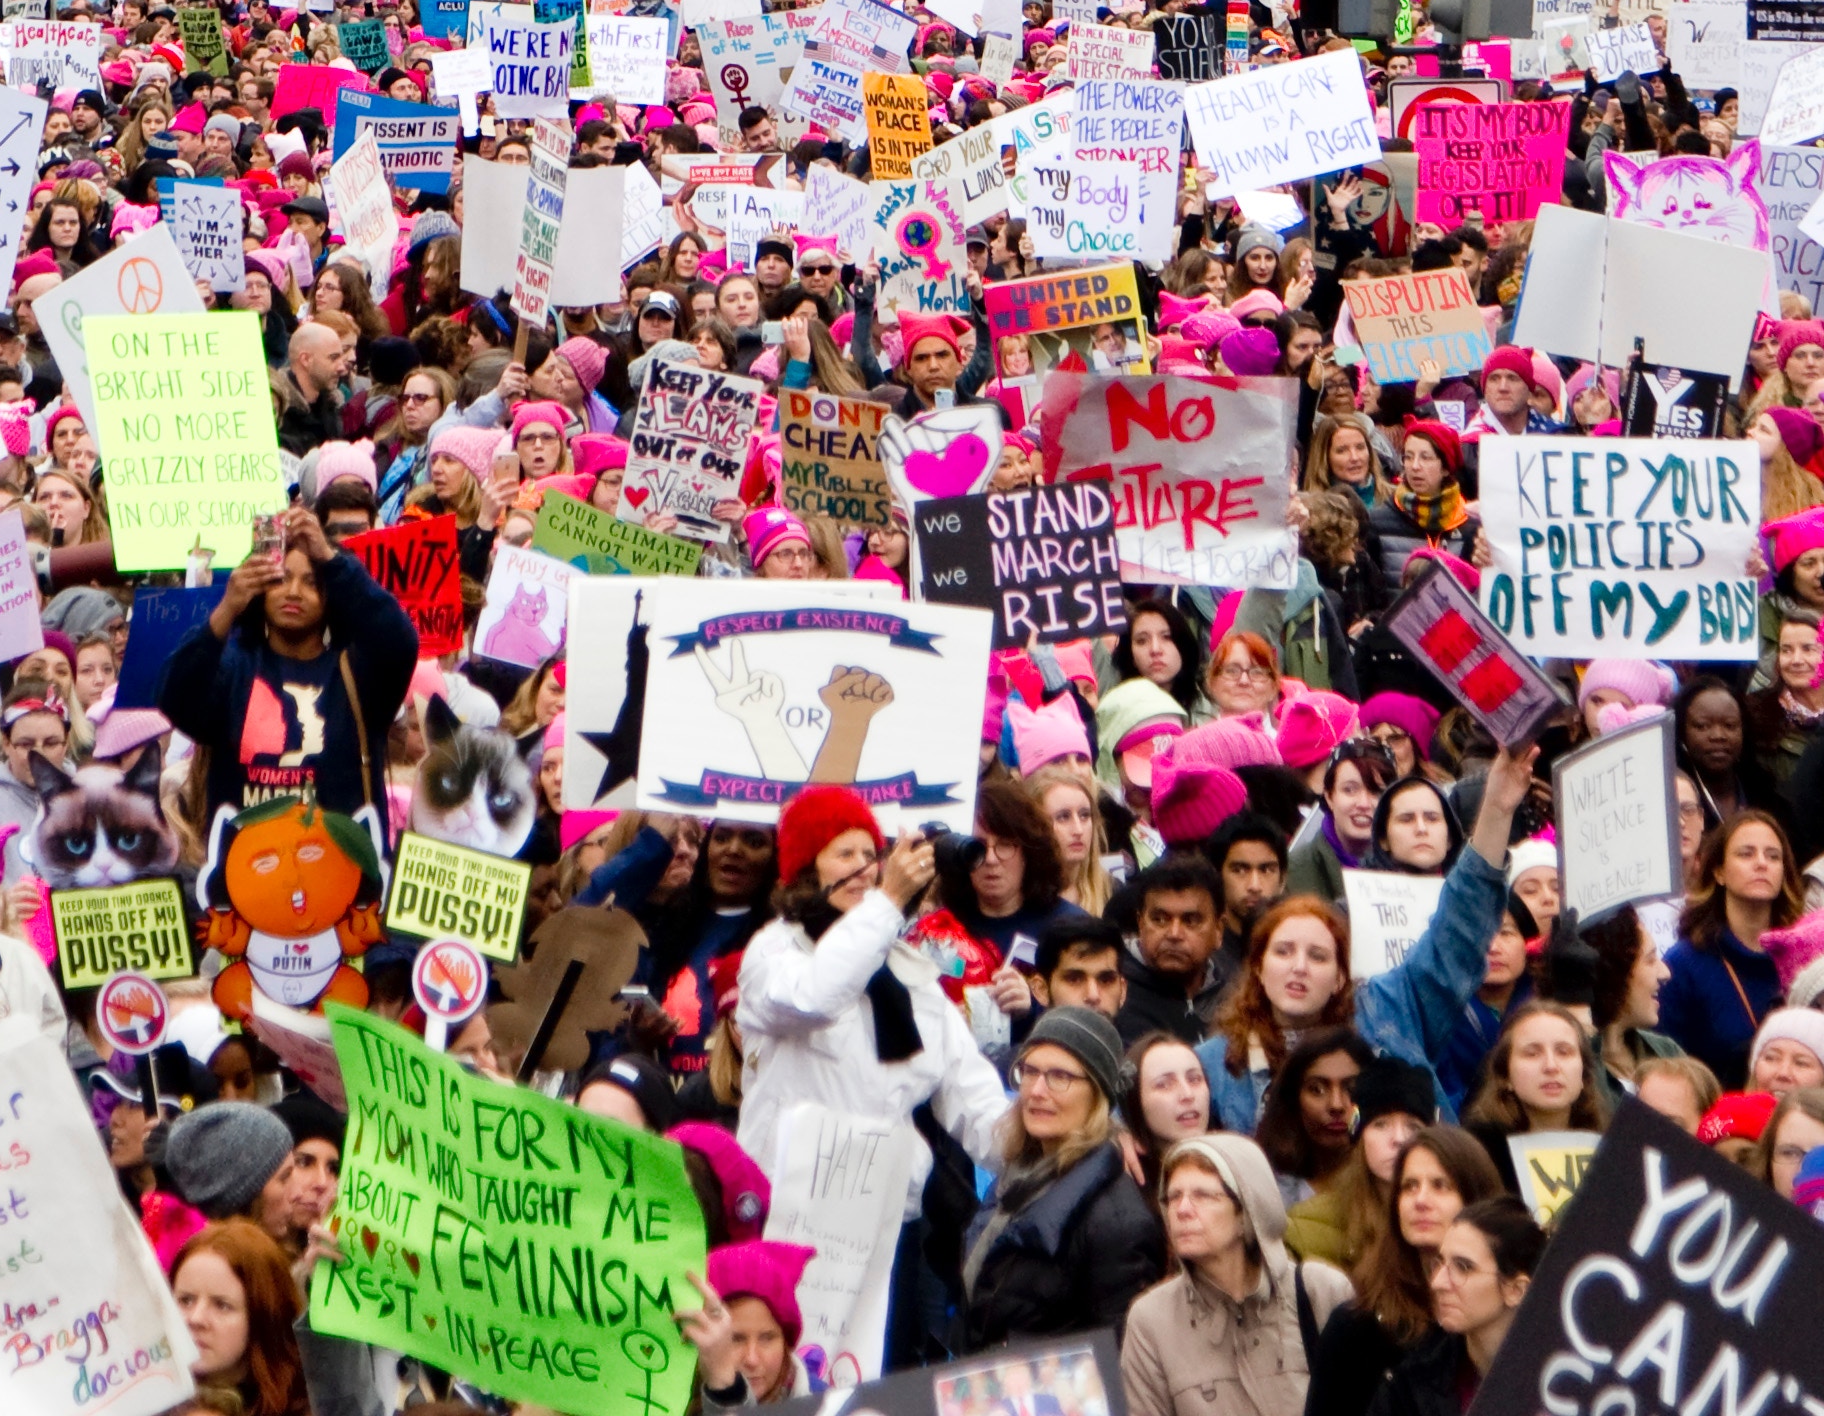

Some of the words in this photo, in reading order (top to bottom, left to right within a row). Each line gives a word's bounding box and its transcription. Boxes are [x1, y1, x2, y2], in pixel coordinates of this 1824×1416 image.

[438, 2, 464, 11] ACLU
[1035, 164, 1070, 200] my
[1076, 175, 1129, 209] Body
[1035, 206, 1064, 239] my
[1066, 220, 1142, 251] Choice.
[994, 308, 1032, 328] WE
[1046, 293, 1131, 326] STAND
[1011, 274, 1109, 305] UNITED
[112, 332, 150, 358] ON
[160, 331, 221, 356] THE
[95, 371, 184, 401] BRIGHT
[200, 371, 257, 398] SIDE
[121, 416, 163, 442] NO
[176, 411, 247, 440] MORE
[109, 455, 204, 486] GRIZZLY
[215, 454, 278, 481] BEARS
[1515, 453, 1629, 520] KEEP
[1636, 455, 1751, 524] YOUR
[924, 513, 962, 534] we
[987, 490, 1109, 539] STAND
[991, 538, 1117, 586] MARCH
[1521, 523, 1704, 569] POLICIES
[934, 566, 968, 586] we
[1004, 588, 1126, 636] RISE
[1489, 572, 1574, 637] OFF
[1591, 583, 1688, 648] MY
[1699, 583, 1758, 641] BODY
[703, 612, 785, 640] RESPECT
[796, 611, 901, 639] EXISTENCE
[785, 705, 824, 732] OR
[62, 914, 114, 935] HANDS
[119, 910, 149, 929] OFF
[155, 907, 176, 925] MY
[65, 934, 181, 976] PUSSY!
[353, 1018, 425, 1109] THIS
[439, 1069, 460, 1136] IS
[473, 1102, 561, 1164] FOR
[569, 1114, 635, 1185] MY
[354, 1097, 415, 1167] MOM
[418, 1138, 466, 1200] WHO
[471, 1164, 573, 1229] TAUGHT
[602, 1195, 669, 1242] ME
[342, 1174, 418, 1238] ABOUT
[432, 1209, 673, 1328] FEMINISM
[325, 1254, 416, 1334] REST
[445, 1304, 473, 1357] IN
[496, 1325, 599, 1380] PEACE
